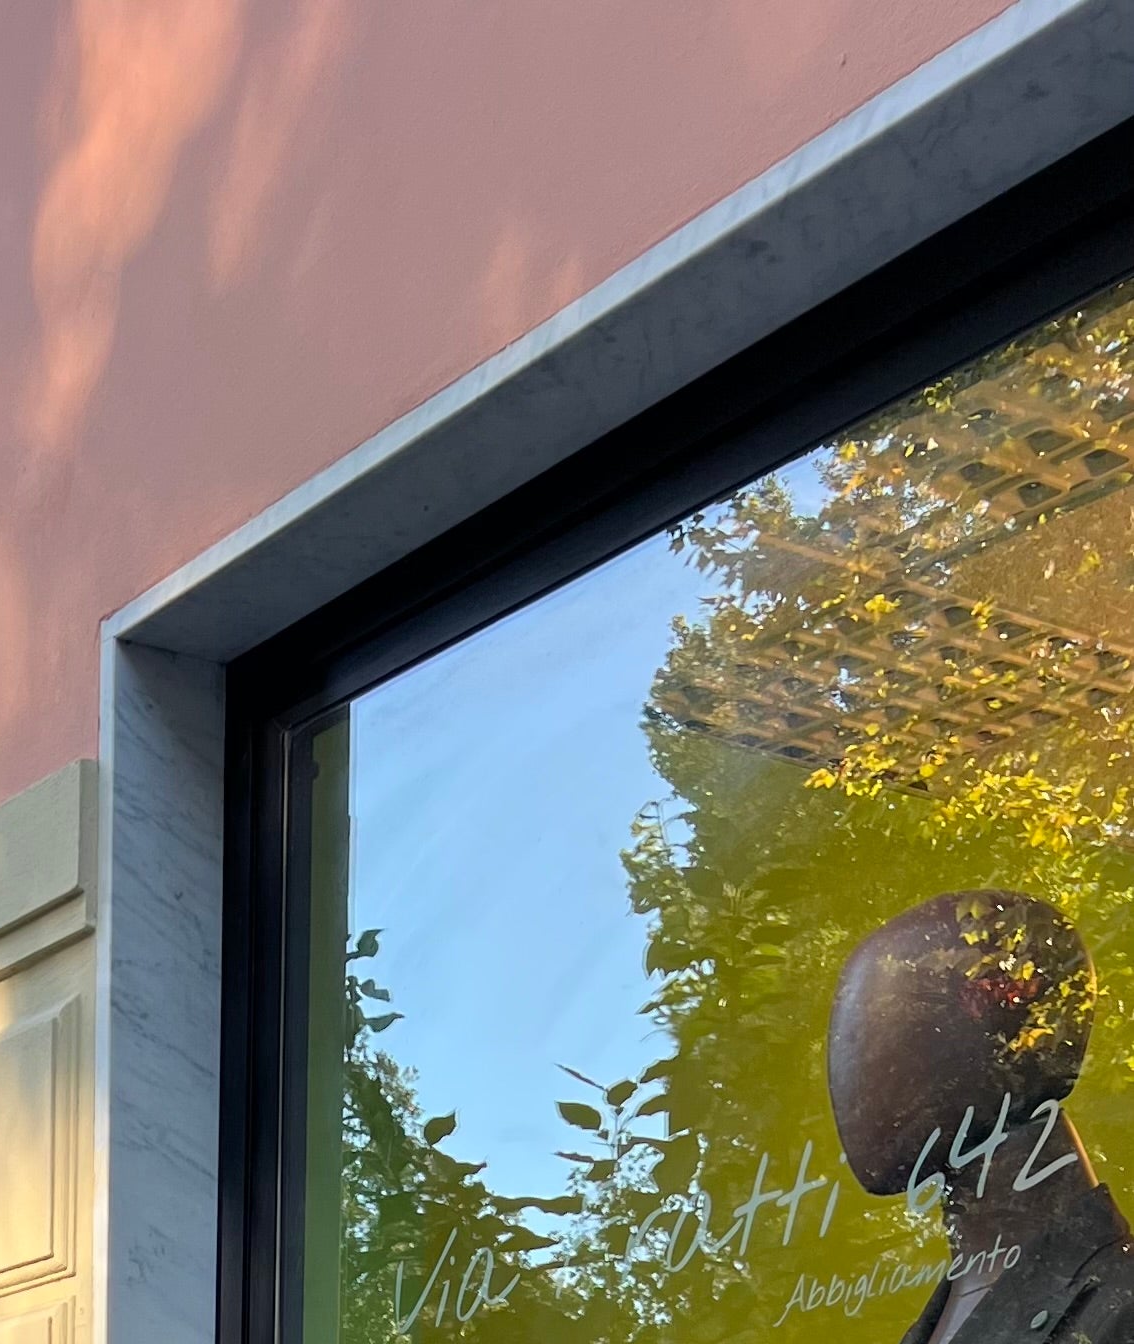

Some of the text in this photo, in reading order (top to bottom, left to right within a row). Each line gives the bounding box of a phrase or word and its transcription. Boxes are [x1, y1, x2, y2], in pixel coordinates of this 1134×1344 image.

[394, 1227, 521, 1335] Via
[906, 1091, 1078, 1214] 642
[772, 1233, 1022, 1328] Abbigliamento
